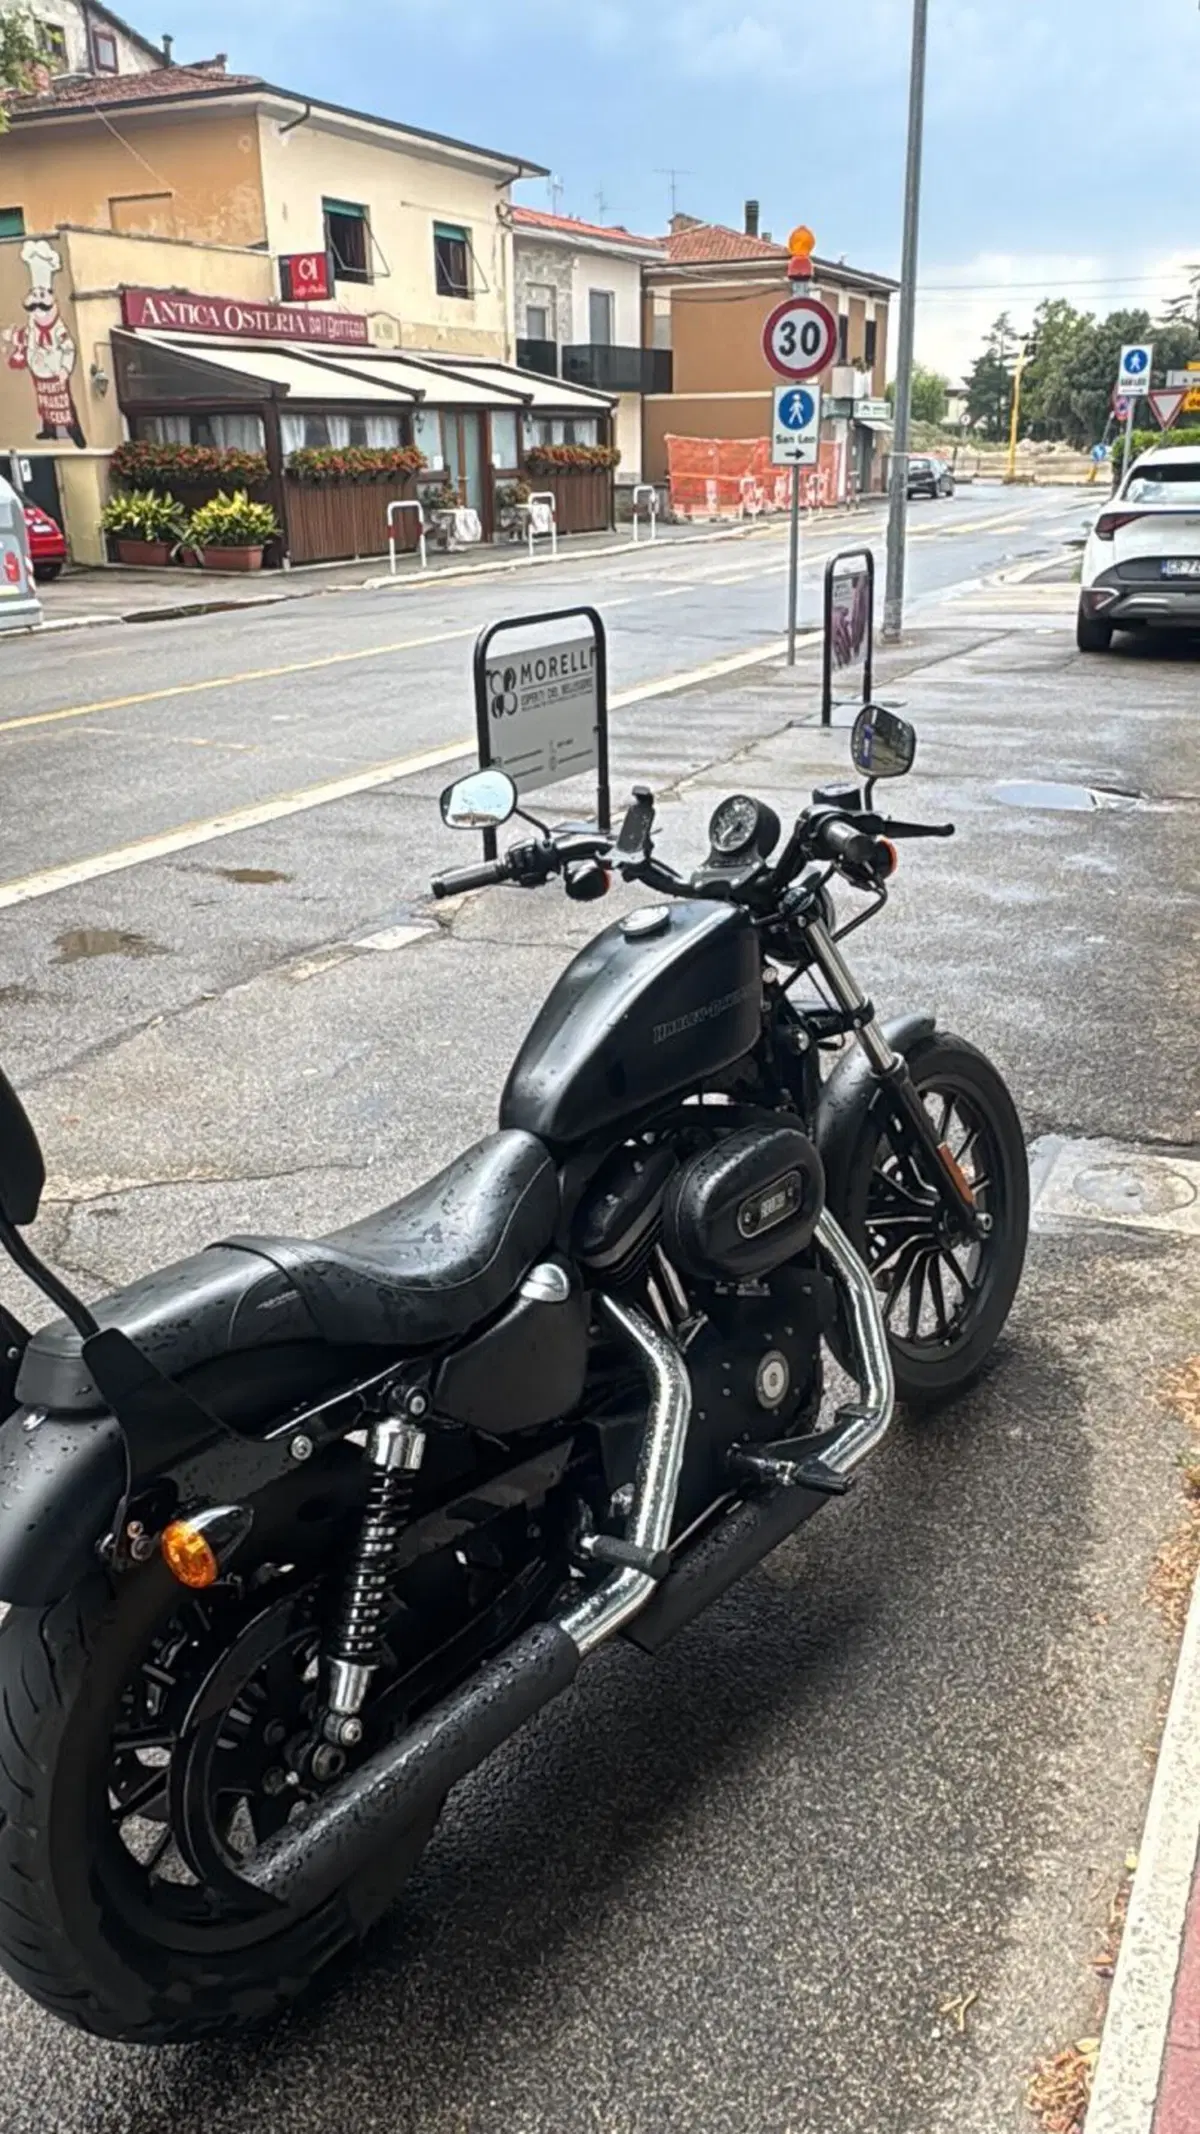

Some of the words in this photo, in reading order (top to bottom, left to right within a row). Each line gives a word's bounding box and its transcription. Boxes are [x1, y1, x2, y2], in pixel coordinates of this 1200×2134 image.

[141, 297, 220, 326] ANTICA
[224, 304, 305, 334] OSTERIA
[779, 320, 821, 357] 30
[38, 392, 69, 408] PRANZO
[51, 410, 70, 423] CENA
[776, 434, 795, 444] San
[798, 433, 816, 444] Leo
[520, 647, 593, 685] MORELLI
